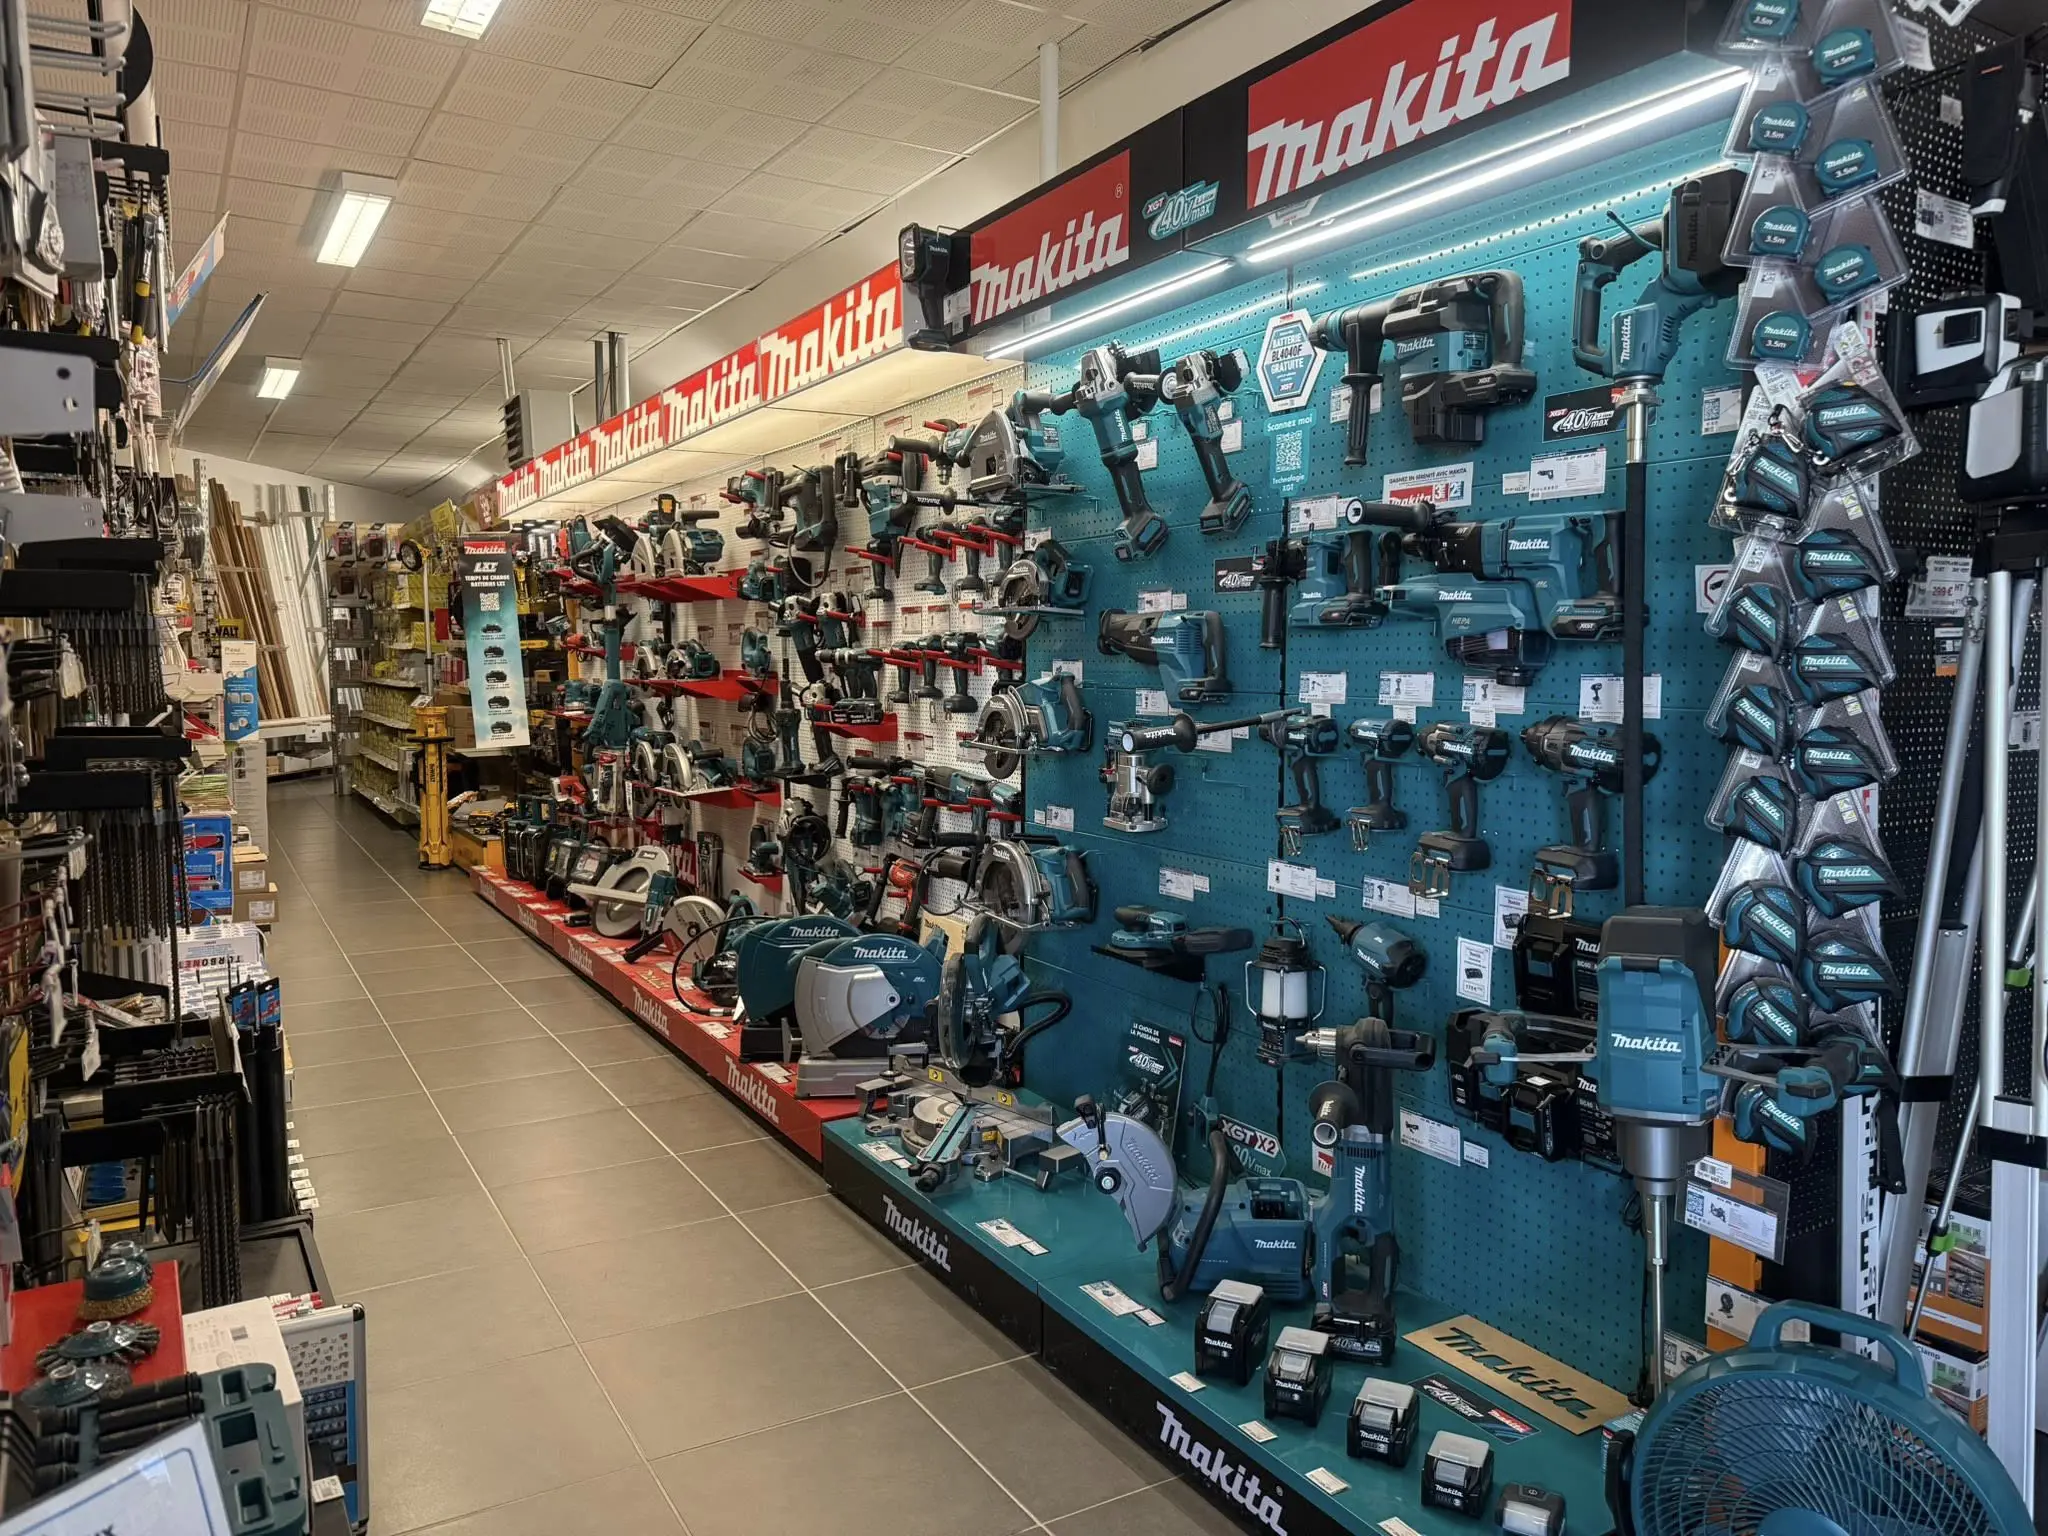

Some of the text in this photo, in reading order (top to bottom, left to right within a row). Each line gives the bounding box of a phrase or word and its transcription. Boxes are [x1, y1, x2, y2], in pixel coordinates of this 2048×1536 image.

[1192, 203, 1211, 221] max
[1765, 339, 1786, 350] 3.5m
[1267, 412, 1312, 432] Scannez moi
[1591, 419, 1608, 428] max
[1221, 1120, 1277, 1155] XGT X2
